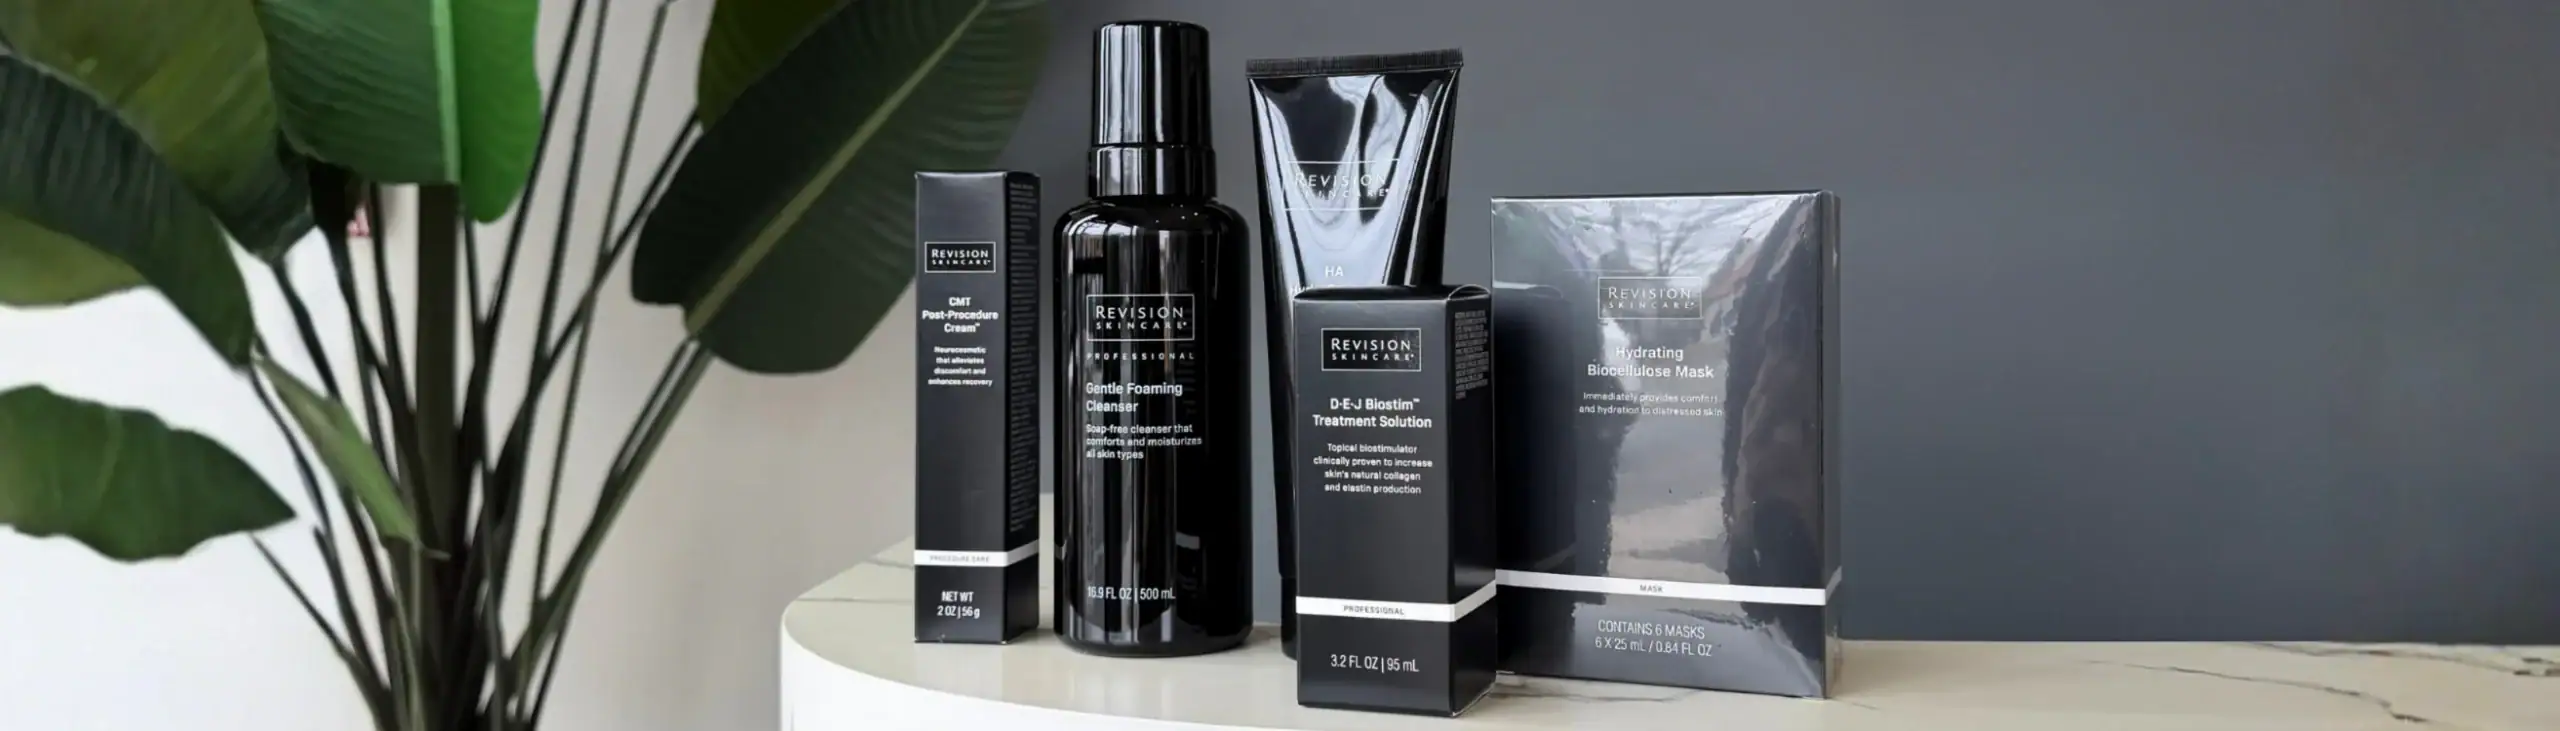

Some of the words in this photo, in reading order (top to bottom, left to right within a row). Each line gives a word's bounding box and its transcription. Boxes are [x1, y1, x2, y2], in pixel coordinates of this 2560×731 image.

[1295, 173, 1385, 187] REVISION
[932, 248, 988, 258] REVISION
[1325, 265, 1344, 278] HA
[1608, 286, 1691, 299] REVISION
[948, 297, 971, 306] CMT
[922, 310, 998, 320] Post-Procedure
[1096, 305, 1183, 319] REVISION
[1331, 338, 1411, 350] REVISION
[1087, 352, 1194, 360] PROFESSIONAL
[1616, 345, 1684, 362] Hydrating
[934, 367, 972, 375] discomfort
[973, 367, 986, 375] and
[1587, 364, 1671, 377] Biocellulose
[1675, 365, 1715, 378] Mask
[962, 379, 993, 387] recovery
[1086, 382, 1124, 395] Gentle
[1127, 382, 1183, 396] Foaming
[1583, 392, 1637, 403] Immediately
[1640, 393, 1678, 403] provides
[1086, 400, 1139, 412] Cleanser
[1579, 405, 1595, 413] and
[1597, 405, 1639, 416] hydration
[1642, 406, 1650, 415] to
[1652, 407, 1701, 416] distressed
[1703, 408, 1723, 416] skin
[1312, 415, 1377, 427] Treatment
[1379, 415, 1432, 428] Solution
[1086, 424, 1128, 434] Soap-free
[1130, 424, 1172, 434] cleanser
[1174, 424, 1193, 433] that
[1086, 437, 1125, 446] comforts
[1127, 437, 1145, 446] and
[1147, 437, 1203, 446] moisturizes
[1086, 449, 1096, 458] all
[1097, 449, 1115, 458] skin
[1117, 450, 1144, 460] types
[1328, 443, 1358, 453] Topical
[1360, 443, 1417, 454] biostimulator
[1313, 456, 1350, 467] clinically
[1352, 458, 1382, 467] proven
[1384, 458, 1393, 467] to
[1395, 458, 1433, 468] increase
[1351, 471, 1381, 480] natural
[1384, 472, 1421, 482] collagen
[1324, 483, 1341, 492] and
[1342, 484, 1372, 493] elastin
[1373, 485, 1422, 494] production
[1088, 586, 1104, 598] 16.9
[1106, 587, 1117, 599] FL
[1119, 587, 1132, 600] OZ
[1140, 588, 1159, 600] 500
[1160, 588, 1176, 600] mL
[1640, 584, 1663, 593] MASK
[941, 591, 958, 602] NET
[959, 591, 974, 602] WT
[937, 605, 944, 616] 2
[944, 605, 956, 616] OZ
[962, 606, 973, 617] 56
[974, 608, 980, 619] g
[1344, 604, 1405, 616] PROFESSIONAL
[1598, 619, 1652, 636] CONTAINS
[1655, 624, 1662, 636] 6
[1664, 625, 1705, 640] MASKS
[1595, 637, 1602, 649] 6
[1614, 638, 1628, 650] 25
[1630, 639, 1646, 652] mL
[1655, 641, 1678, 654] 0.84
[1681, 642, 1695, 656] FL
[1697, 643, 1713, 657] OZ
[1331, 654, 1346, 668] 3.2
[1349, 655, 1362, 669] FL
[1364, 656, 1378, 670] OZ
[1387, 658, 1400, 671] 95
[1402, 659, 1419, 673] mL
